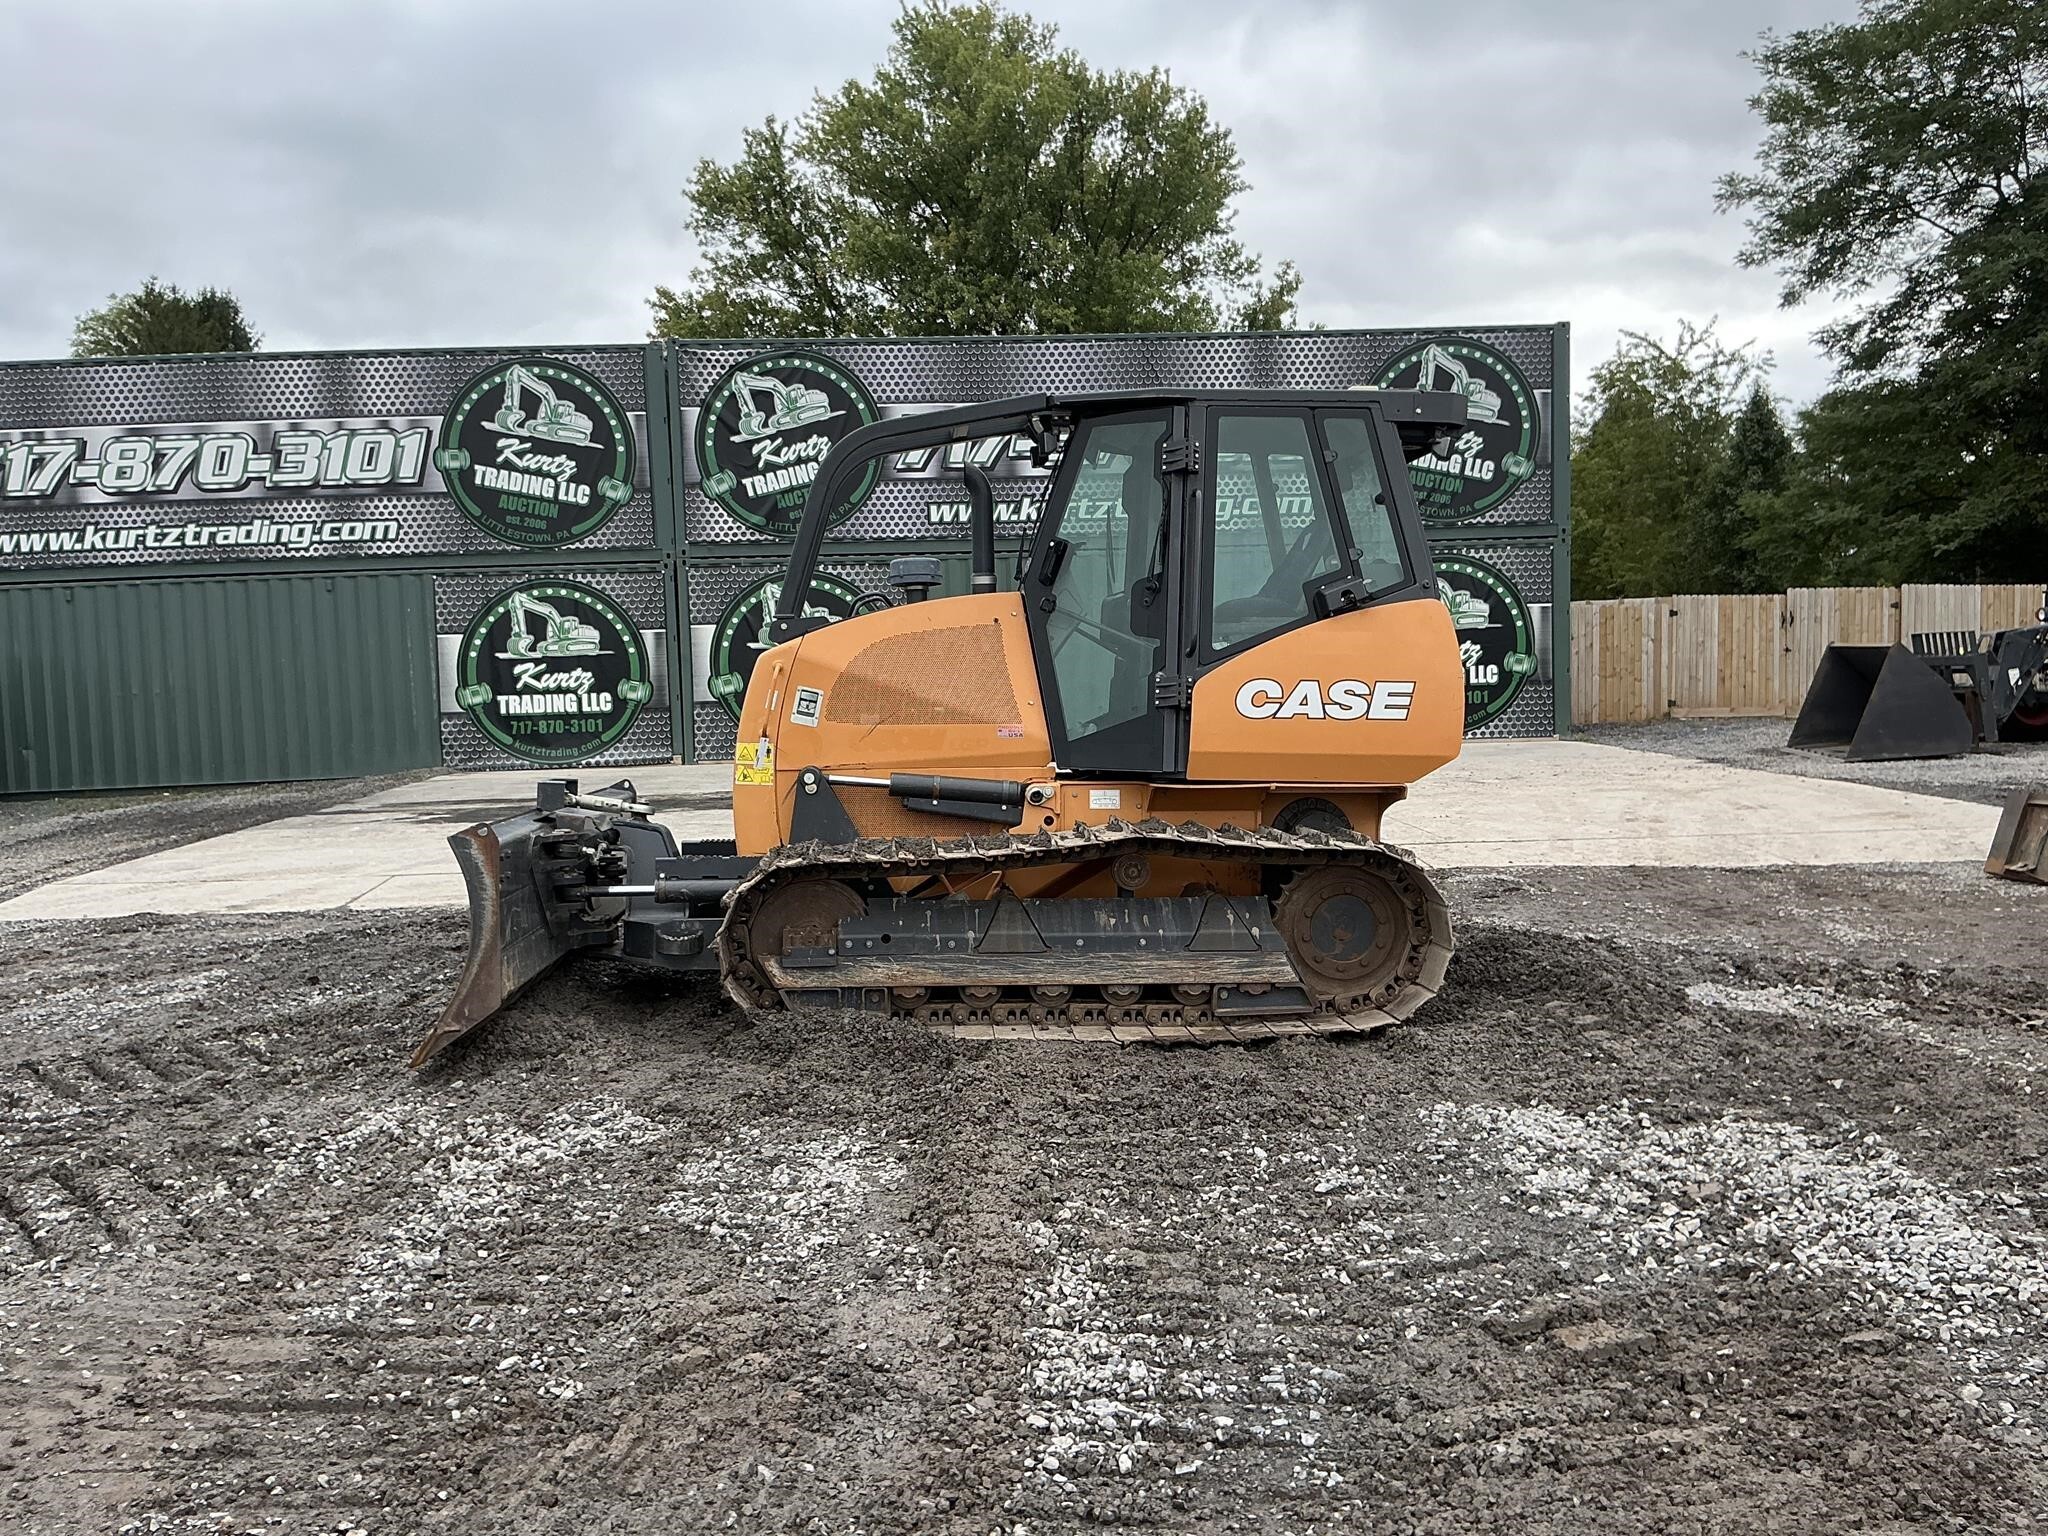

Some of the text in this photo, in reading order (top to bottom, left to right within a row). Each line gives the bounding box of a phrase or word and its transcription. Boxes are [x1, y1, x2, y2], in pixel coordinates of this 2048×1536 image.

[0, 429, 427, 494] 17-870-3101
[496, 438, 578, 481] Kurtz
[751, 434, 832, 469] Kurtz
[1464, 457, 1495, 481] LLC
[474, 465, 591, 504] TRADING LLC
[1409, 470, 1464, 494] AUCTION
[499, 494, 559, 518] AUCTION
[838, 502, 852, 514] PA
[1430, 492, 1451, 504] 2006
[1460, 504, 1472, 514] PA
[481, 514, 570, 542] LITTLESTOWN, PA
[506, 515, 547, 530] est. 2006
[513, 662, 594, 693] Kurtz
[1469, 664, 1499, 684] LLC
[497, 692, 613, 714] TRADING LLC
[1235, 678, 1416, 720] CASE
[510, 719, 603, 734] 717-870-3101
[514, 738, 602, 756] kurtztrading.com
